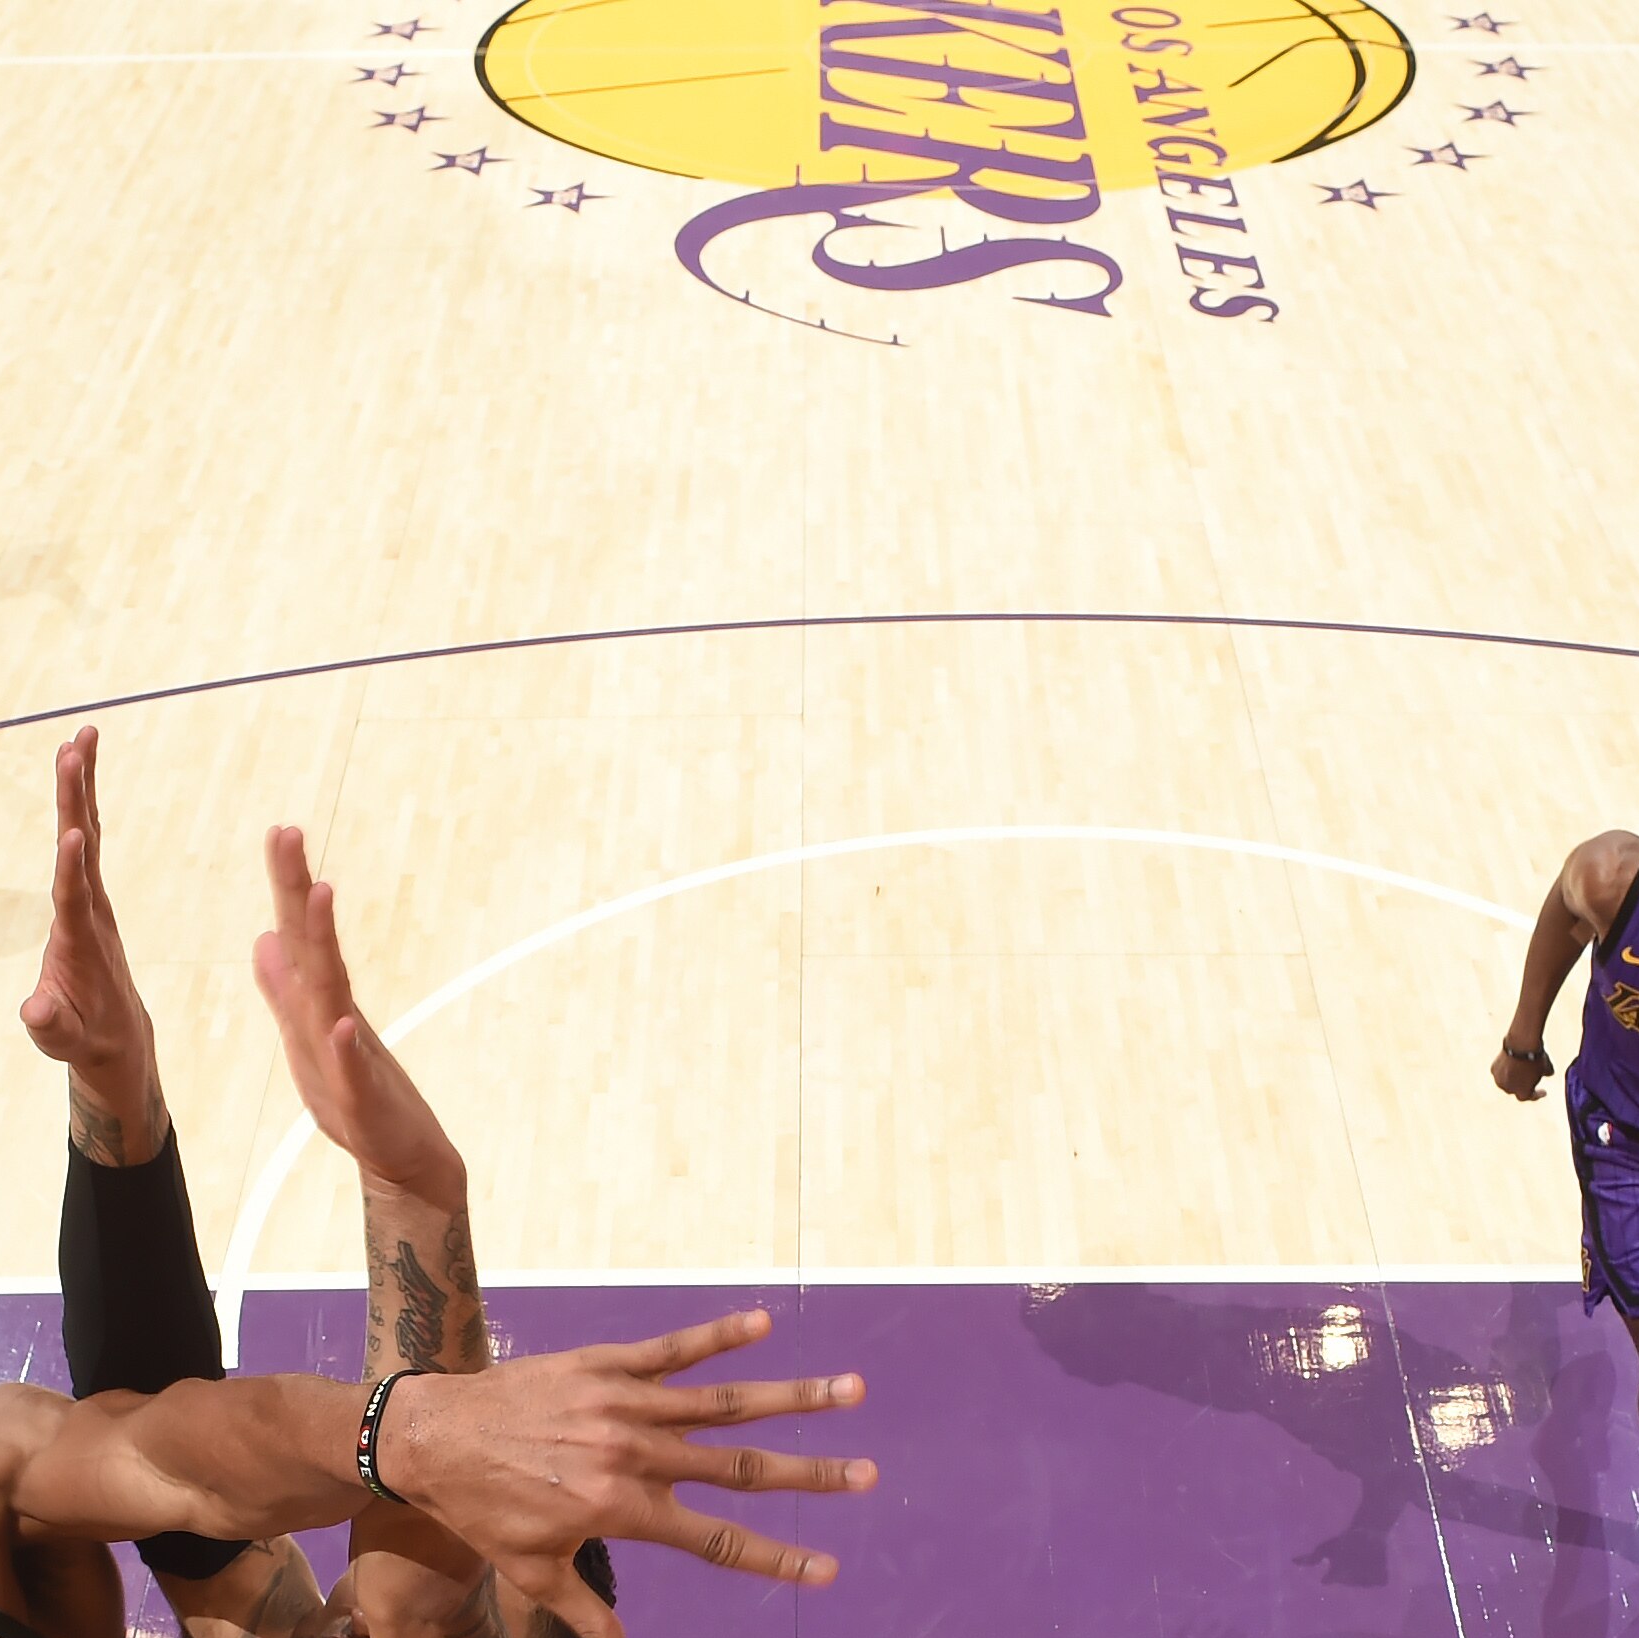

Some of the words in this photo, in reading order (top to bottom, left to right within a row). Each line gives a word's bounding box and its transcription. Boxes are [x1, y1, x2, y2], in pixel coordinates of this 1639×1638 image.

[1111, 0, 1193, 58] OS
[674, 0, 1123, 347] KERS
[1126, 61, 1280, 323] ANGELES
